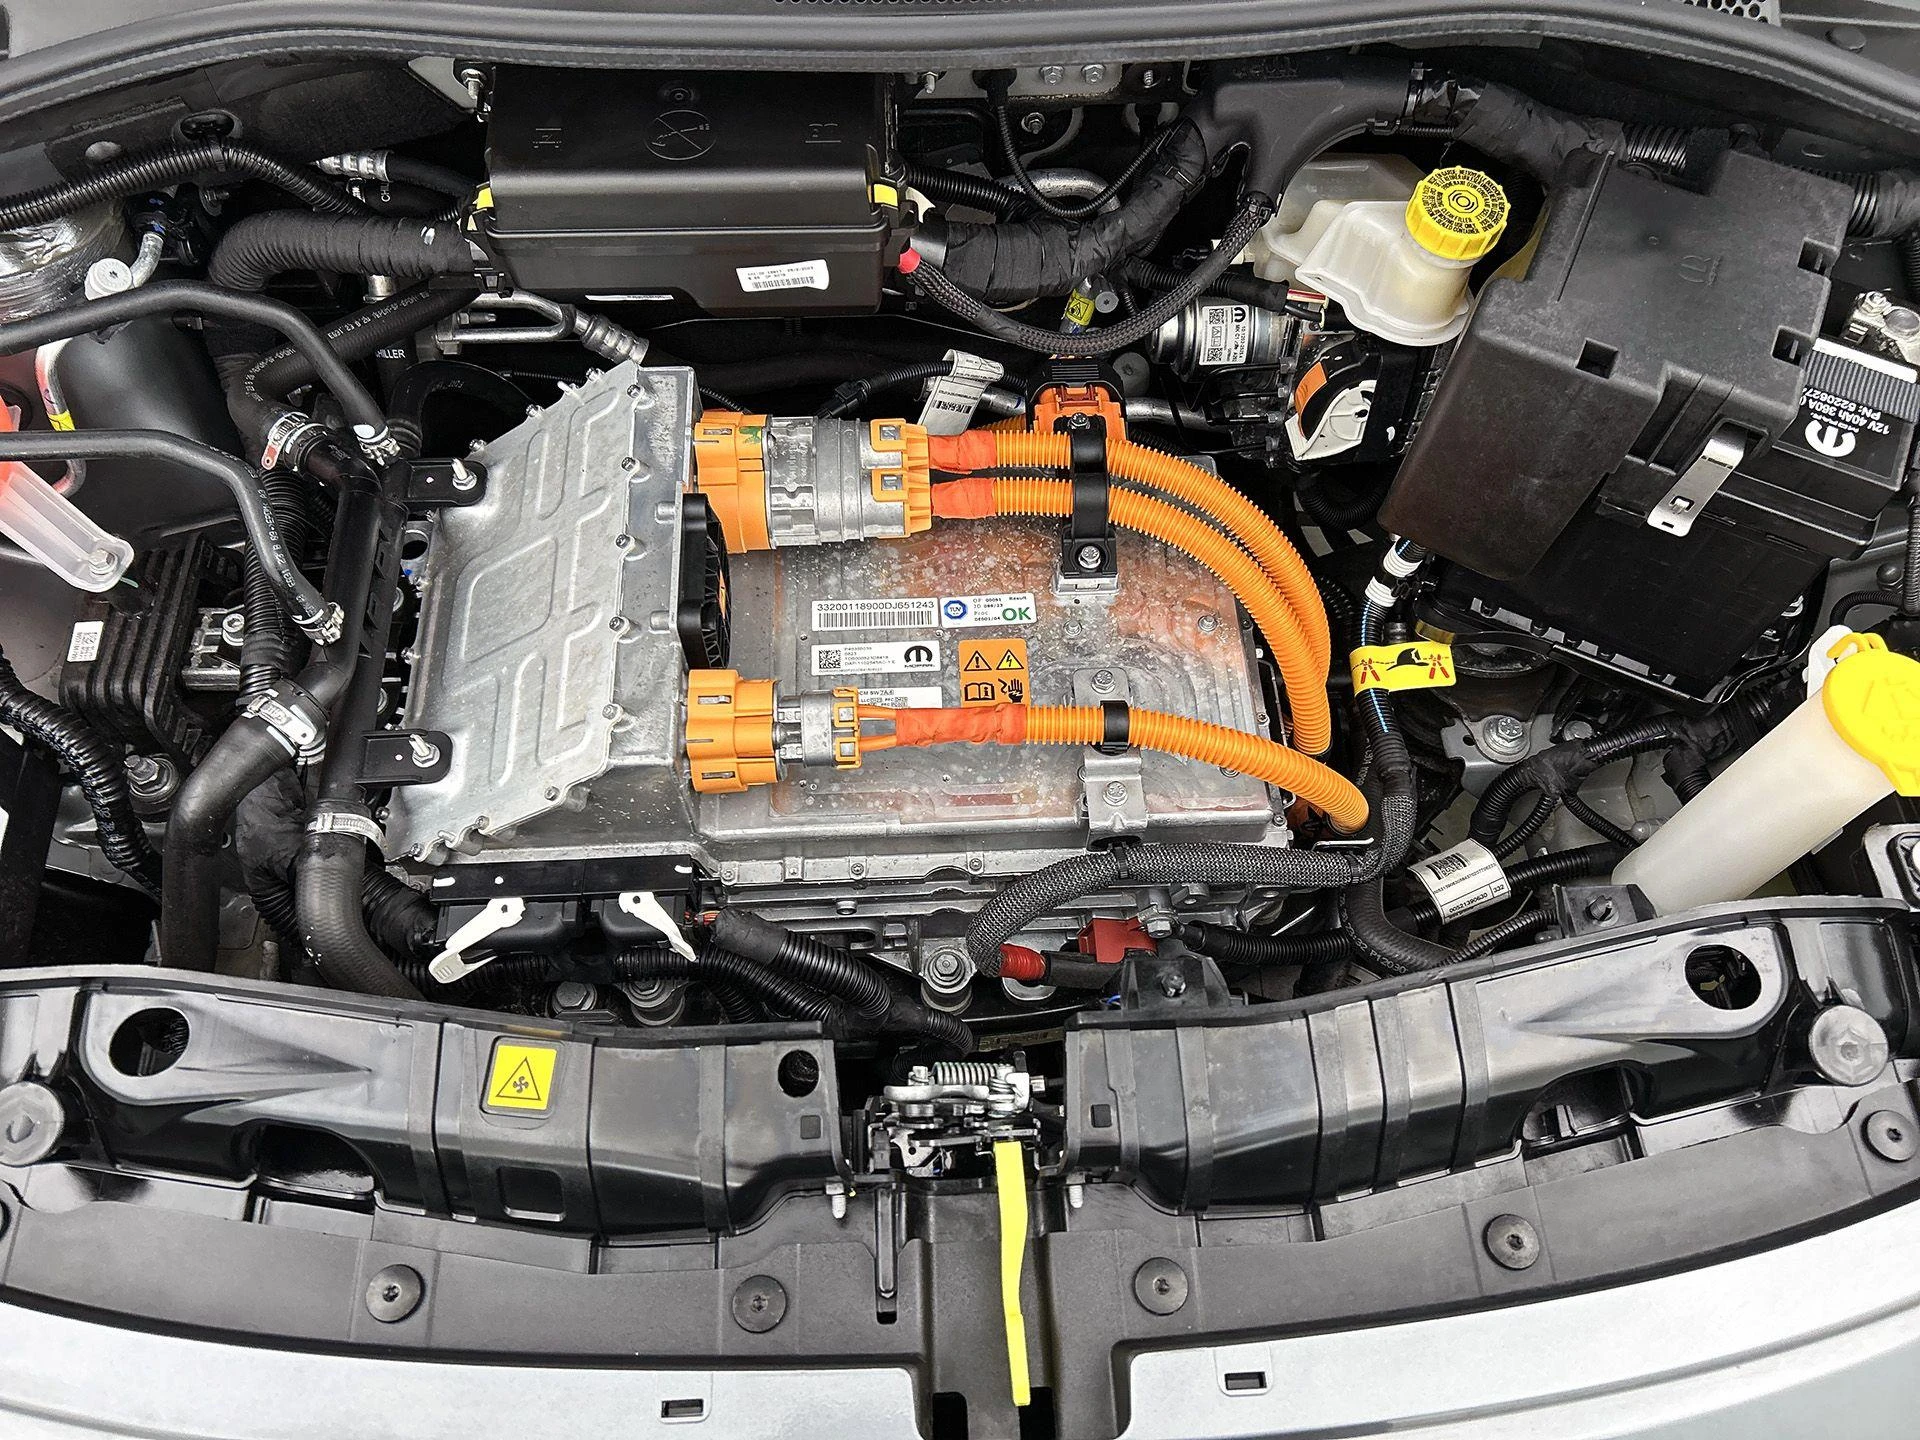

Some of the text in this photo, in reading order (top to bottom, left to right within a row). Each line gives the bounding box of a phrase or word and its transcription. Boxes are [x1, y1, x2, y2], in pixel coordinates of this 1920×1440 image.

[376, 348, 406, 359] HILLER
[1838, 410, 1867, 427] 40Ah
[1858, 405, 1881, 420] PN:
[1867, 420, 1890, 434] 12V
[1002, 606, 1031, 622] OK
